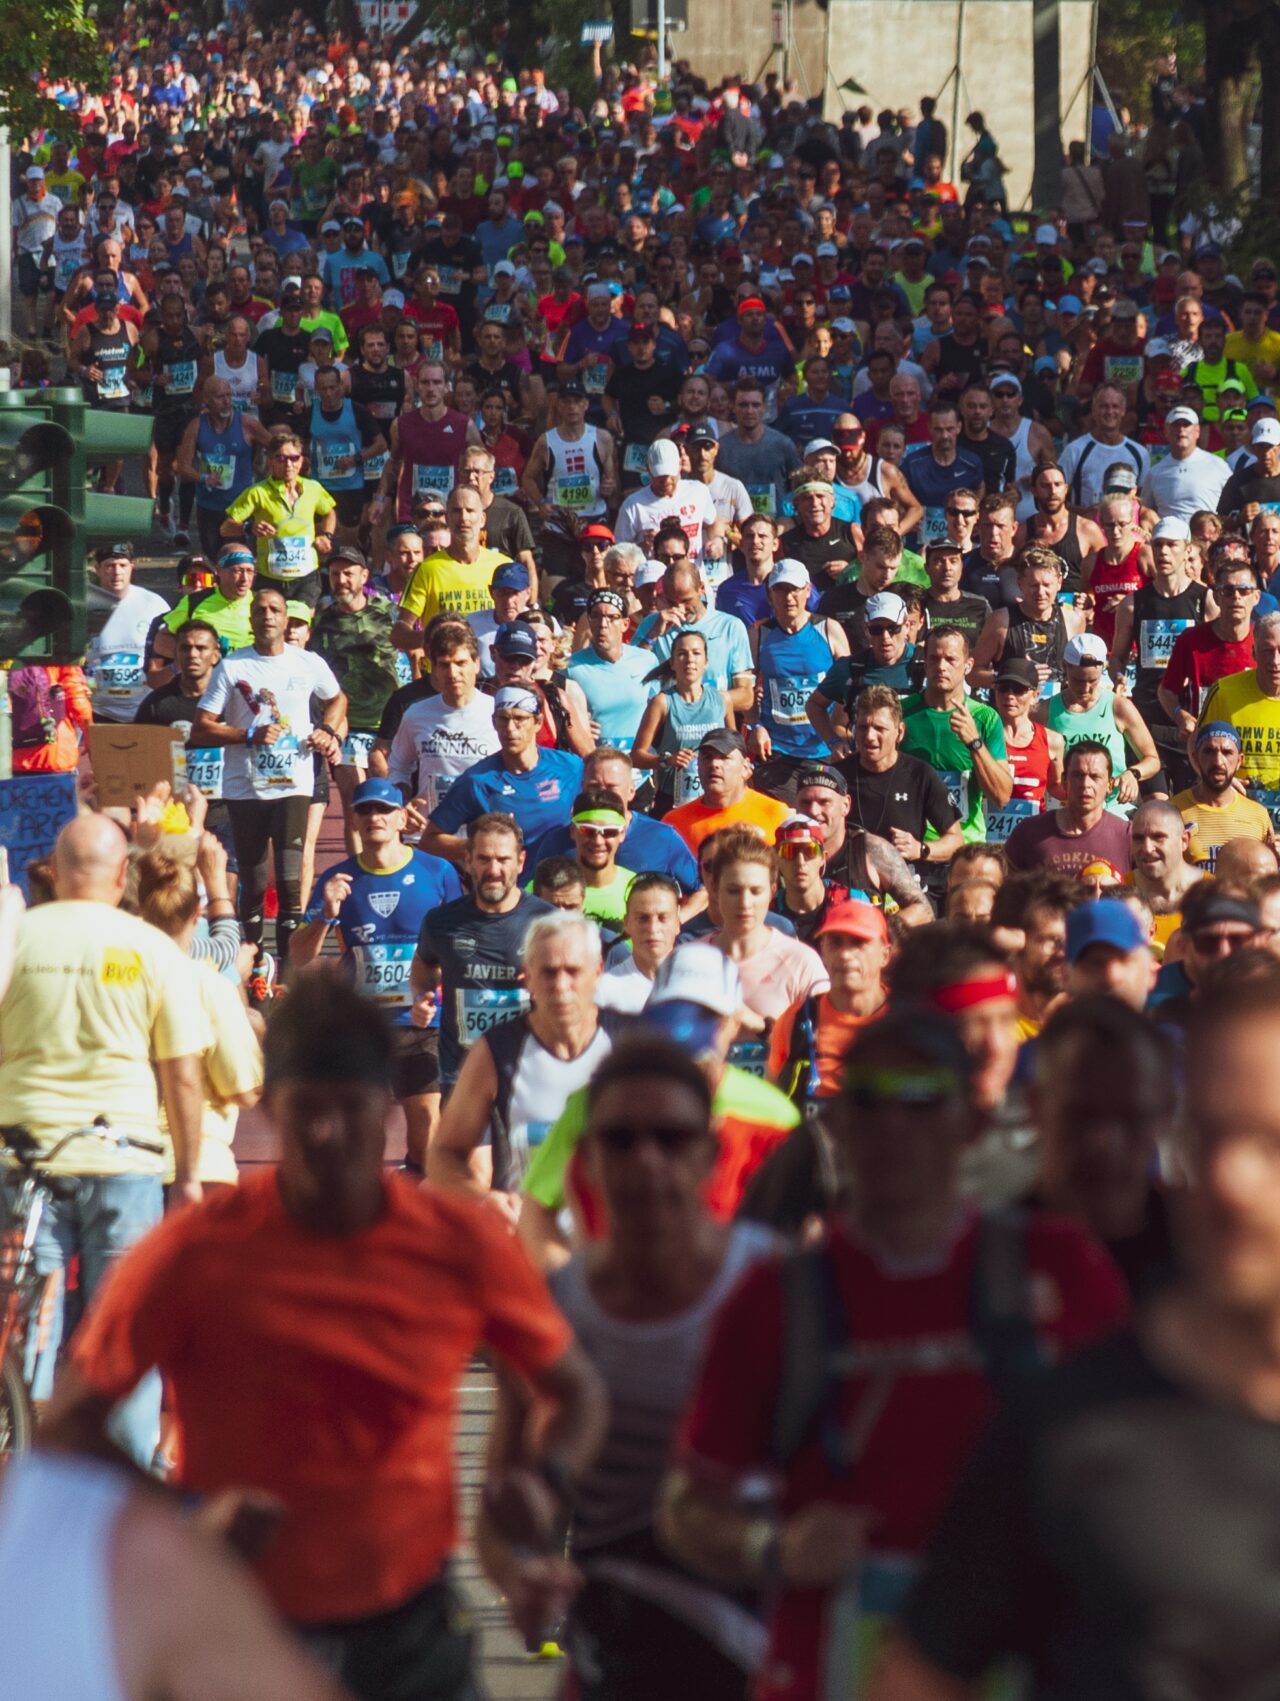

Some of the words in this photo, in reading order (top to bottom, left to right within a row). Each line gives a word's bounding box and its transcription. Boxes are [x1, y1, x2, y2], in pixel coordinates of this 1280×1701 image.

[561, 487, 588, 500] 4190
[466, 588, 490, 600] BERL
[1095, 583, 1138, 594] DENMARK
[439, 600, 493, 612] MARATHO
[675, 722, 719, 734] MIDNIGHT
[1239, 726, 1264, 739] BMW
[675, 731, 704, 743] RUNN
[423, 740, 489, 758] RUNNING
[257, 752, 301, 771] 20247
[684, 775, 701, 792] 15
[366, 964, 411, 984] 25604
[463, 963, 517, 981] JAVIER
[466, 1011, 520, 1032] 561
